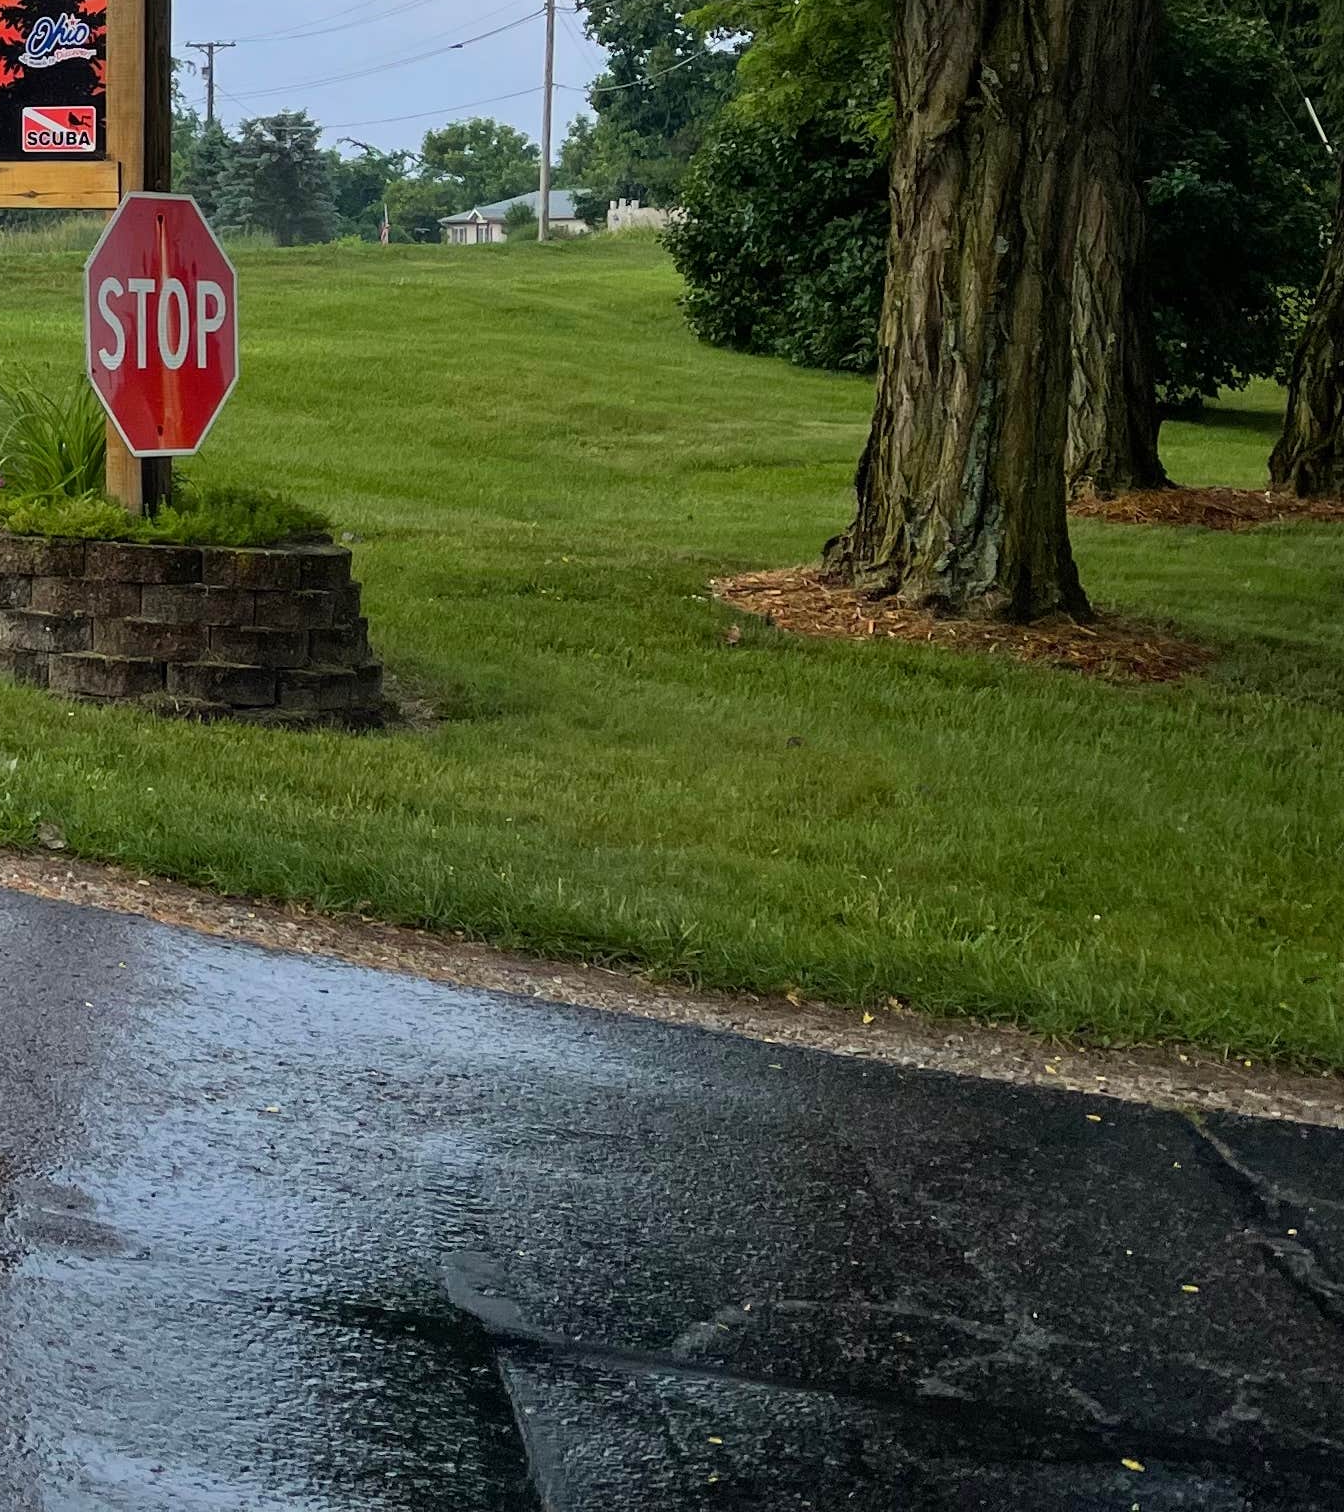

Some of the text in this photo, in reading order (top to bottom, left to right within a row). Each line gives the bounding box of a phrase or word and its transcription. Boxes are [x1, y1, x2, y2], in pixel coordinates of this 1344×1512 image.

[25, 13, 89, 58] Ohio
[27, 131, 90, 146] SCUBA
[98, 277, 226, 371] STOP
